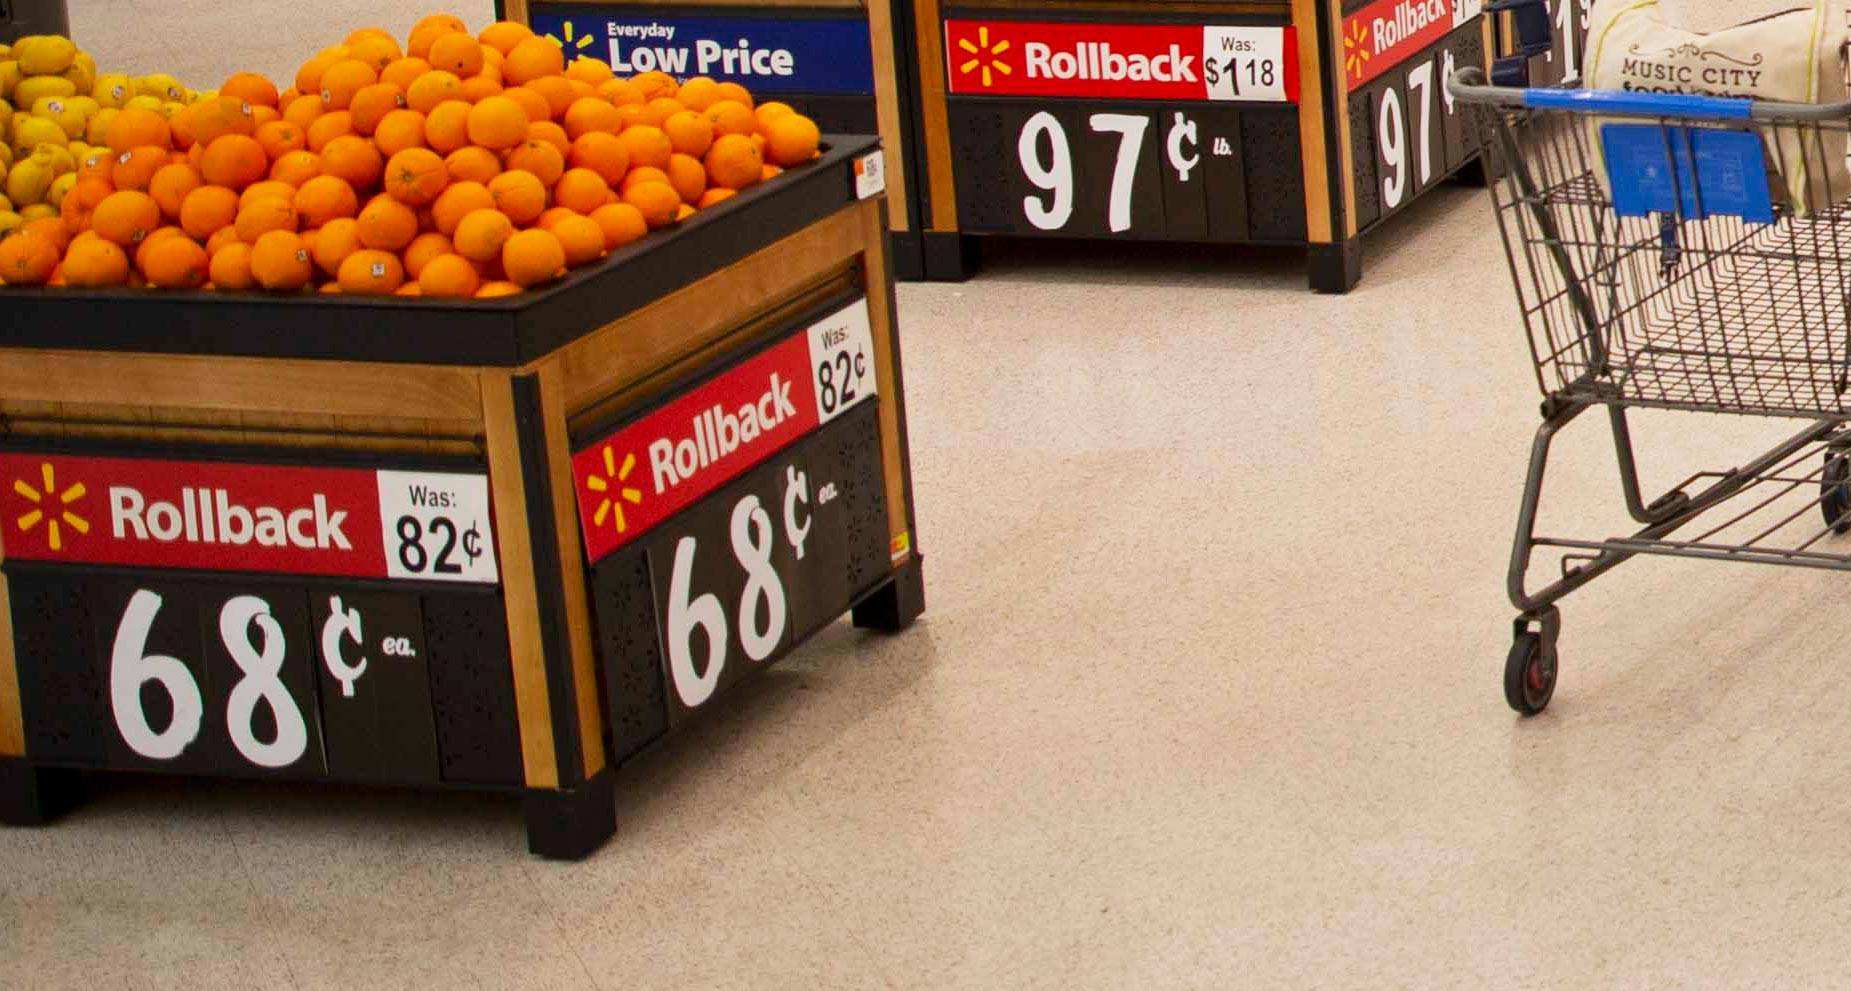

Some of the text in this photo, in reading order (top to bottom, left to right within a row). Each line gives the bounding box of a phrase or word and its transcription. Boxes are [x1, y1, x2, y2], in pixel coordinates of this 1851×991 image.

[607, 22, 675, 40] Everyday
[1220, 36, 1257, 52] Was:
[609, 37, 795, 76] Low Price
[1024, 41, 1198, 83] Rollback
[1622, 58, 1762, 88] MUSIC CITY
[1018, 111, 1232, 233] 97¢ lb.
[820, 325, 849, 349] Was:
[648, 372, 797, 496] Rollback
[409, 485, 457, 508] Was:
[108, 485, 352, 551] Rollback
[668, 464, 811, 708] 68¢
[110, 588, 416, 768] 68¢ ea.
